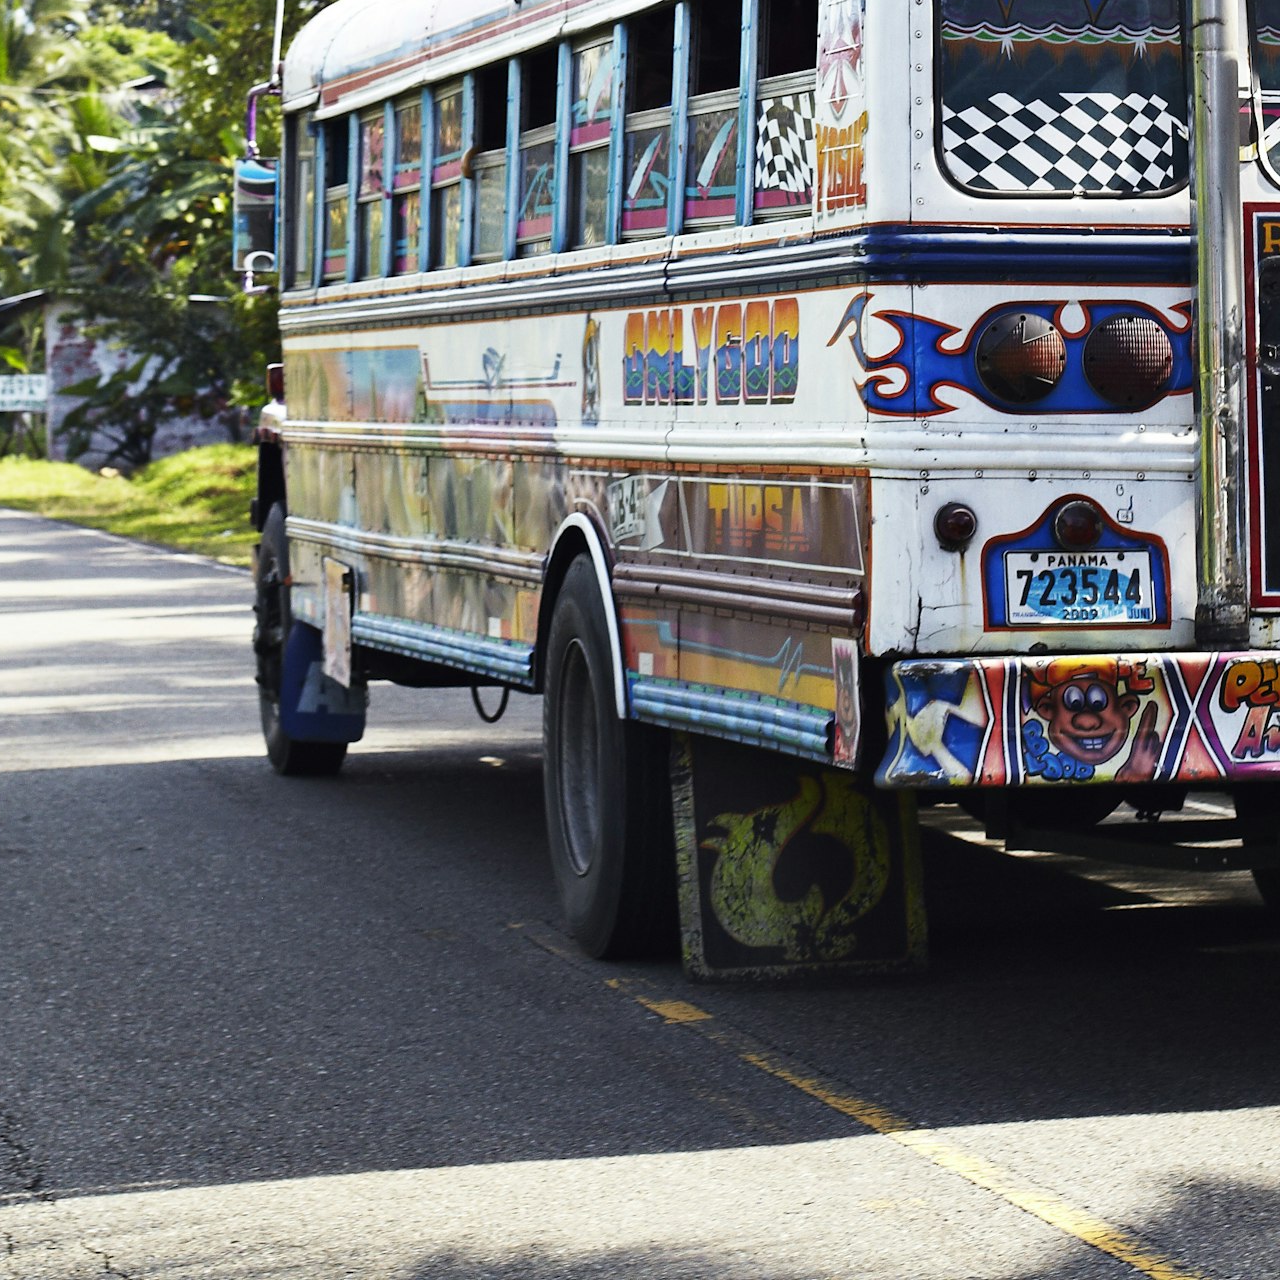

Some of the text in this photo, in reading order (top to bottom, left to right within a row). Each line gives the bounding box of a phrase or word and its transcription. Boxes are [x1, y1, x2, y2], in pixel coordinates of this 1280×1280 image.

[623, 297, 800, 406] ONLY GOD
[1047, 555, 1109, 567] PANAMA
[1016, 568, 1142, 607] 723544
[1062, 608, 1099, 620] 2009
